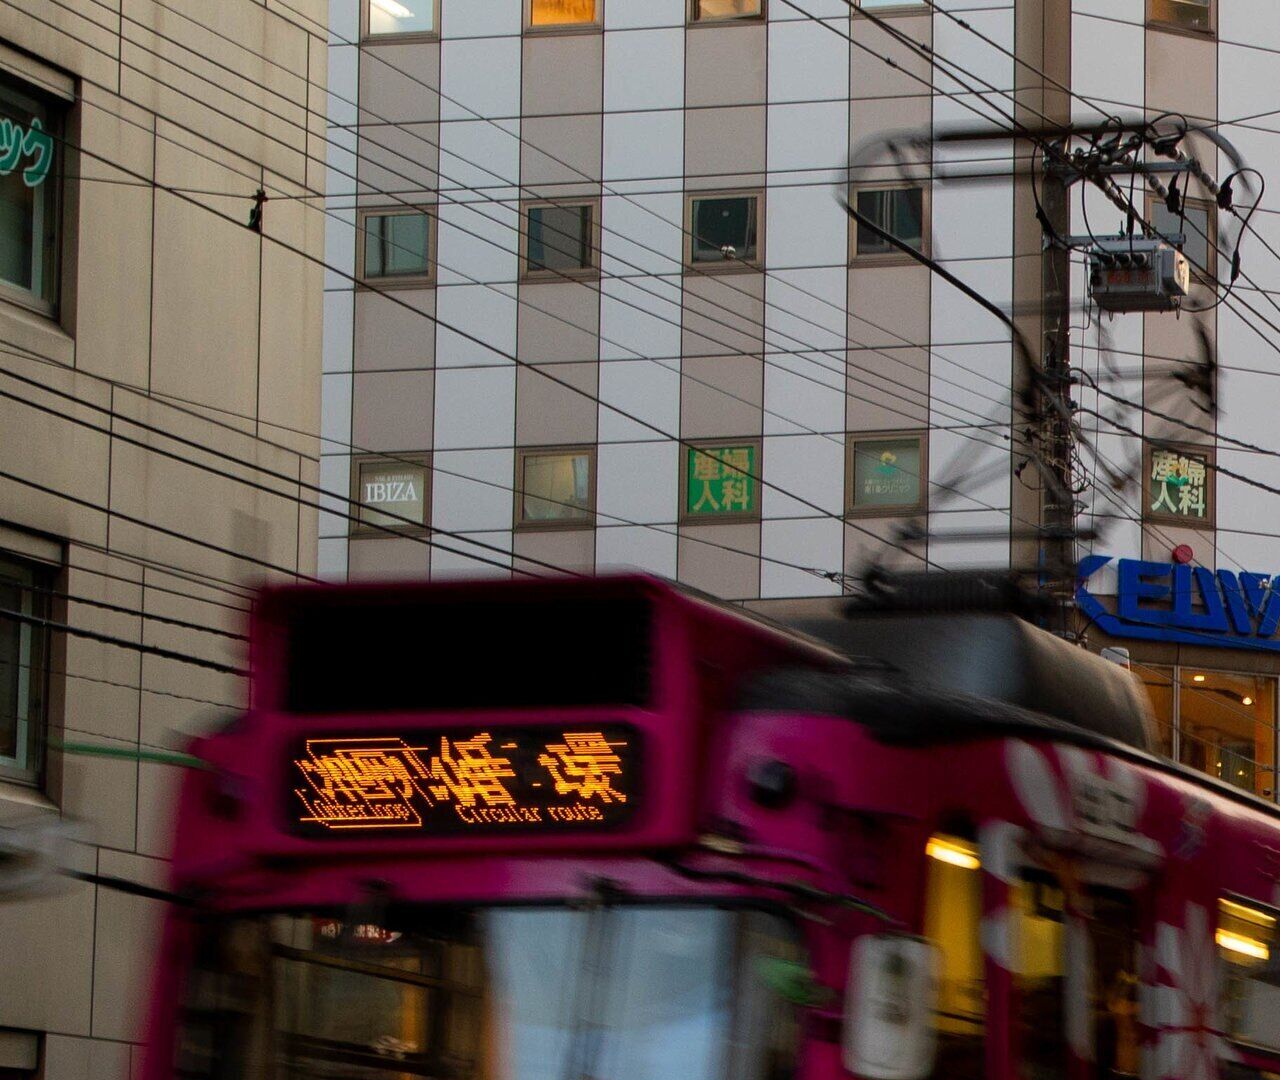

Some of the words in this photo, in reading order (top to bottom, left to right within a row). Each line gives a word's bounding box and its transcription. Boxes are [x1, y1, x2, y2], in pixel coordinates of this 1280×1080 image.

[365, 482, 418, 503] IBIZA
[455, 804, 542, 823] Circular
[547, 803, 603, 821] route
